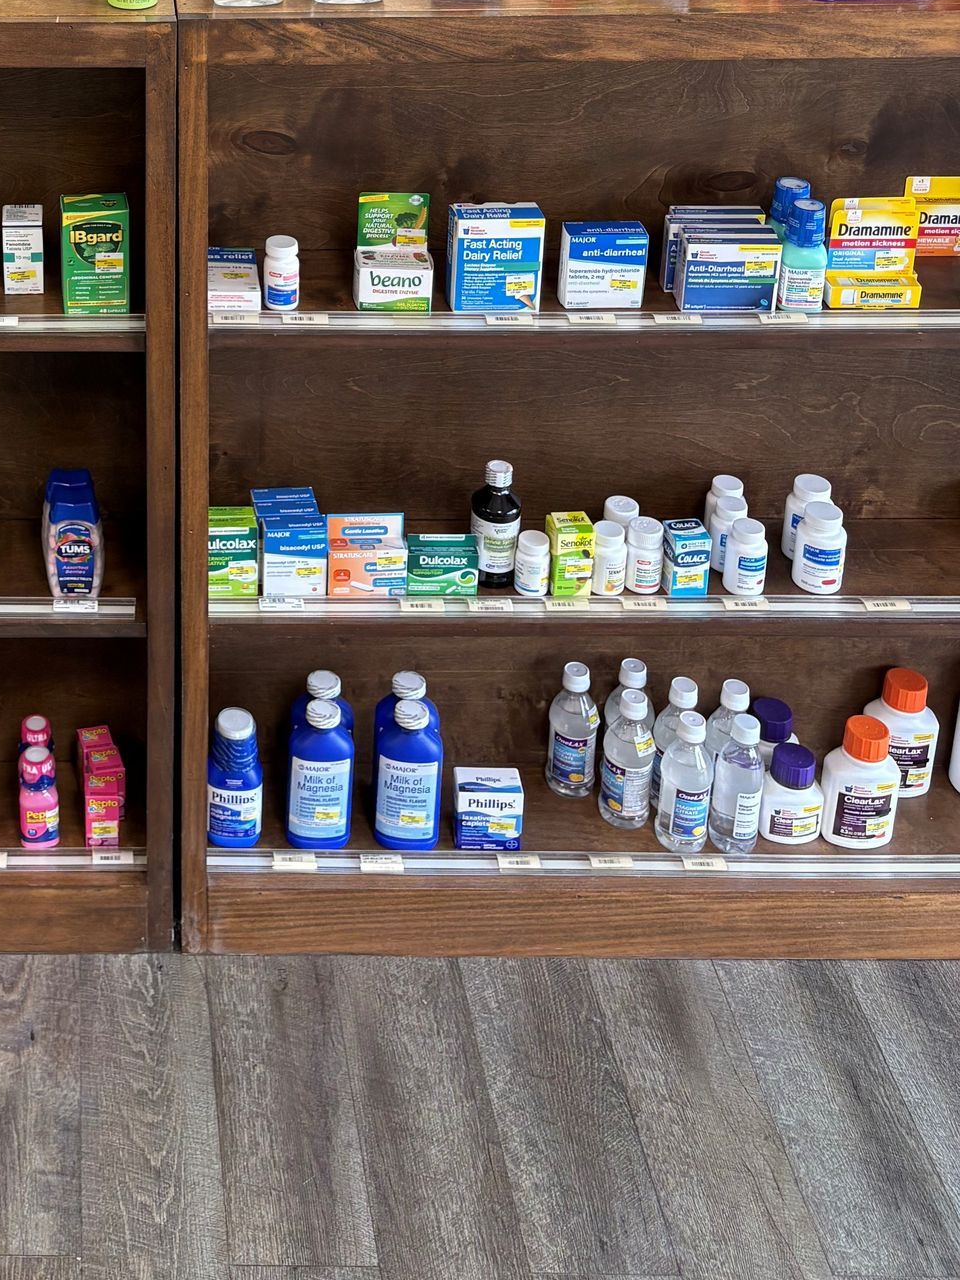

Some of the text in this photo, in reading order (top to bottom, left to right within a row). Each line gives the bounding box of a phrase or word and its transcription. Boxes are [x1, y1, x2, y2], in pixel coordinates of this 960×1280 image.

[839, 224, 911, 237] Dramamine
[70, 231, 123, 244] IBgard
[464, 239, 521, 250] Fast Acting
[464, 250, 522, 262] Dairy Relief
[583, 249, 645, 257] anti-diarrheal
[370, 271, 422, 288] beano
[860, 291, 903, 299] Dramamine
[209, 538, 256, 549] ulcolax
[561, 539, 592, 548] Senokot
[60, 545, 90, 554] TUMS
[420, 556, 467, 565] Dulcolax
[304, 775, 335, 785] Milk of
[390, 774, 422, 785] Milk of
[297, 782, 343, 794] Magnesia
[384, 783, 431, 794] Magnesia
[89, 798, 118, 809] Pepto
[844, 796, 885, 805] ClearLax
